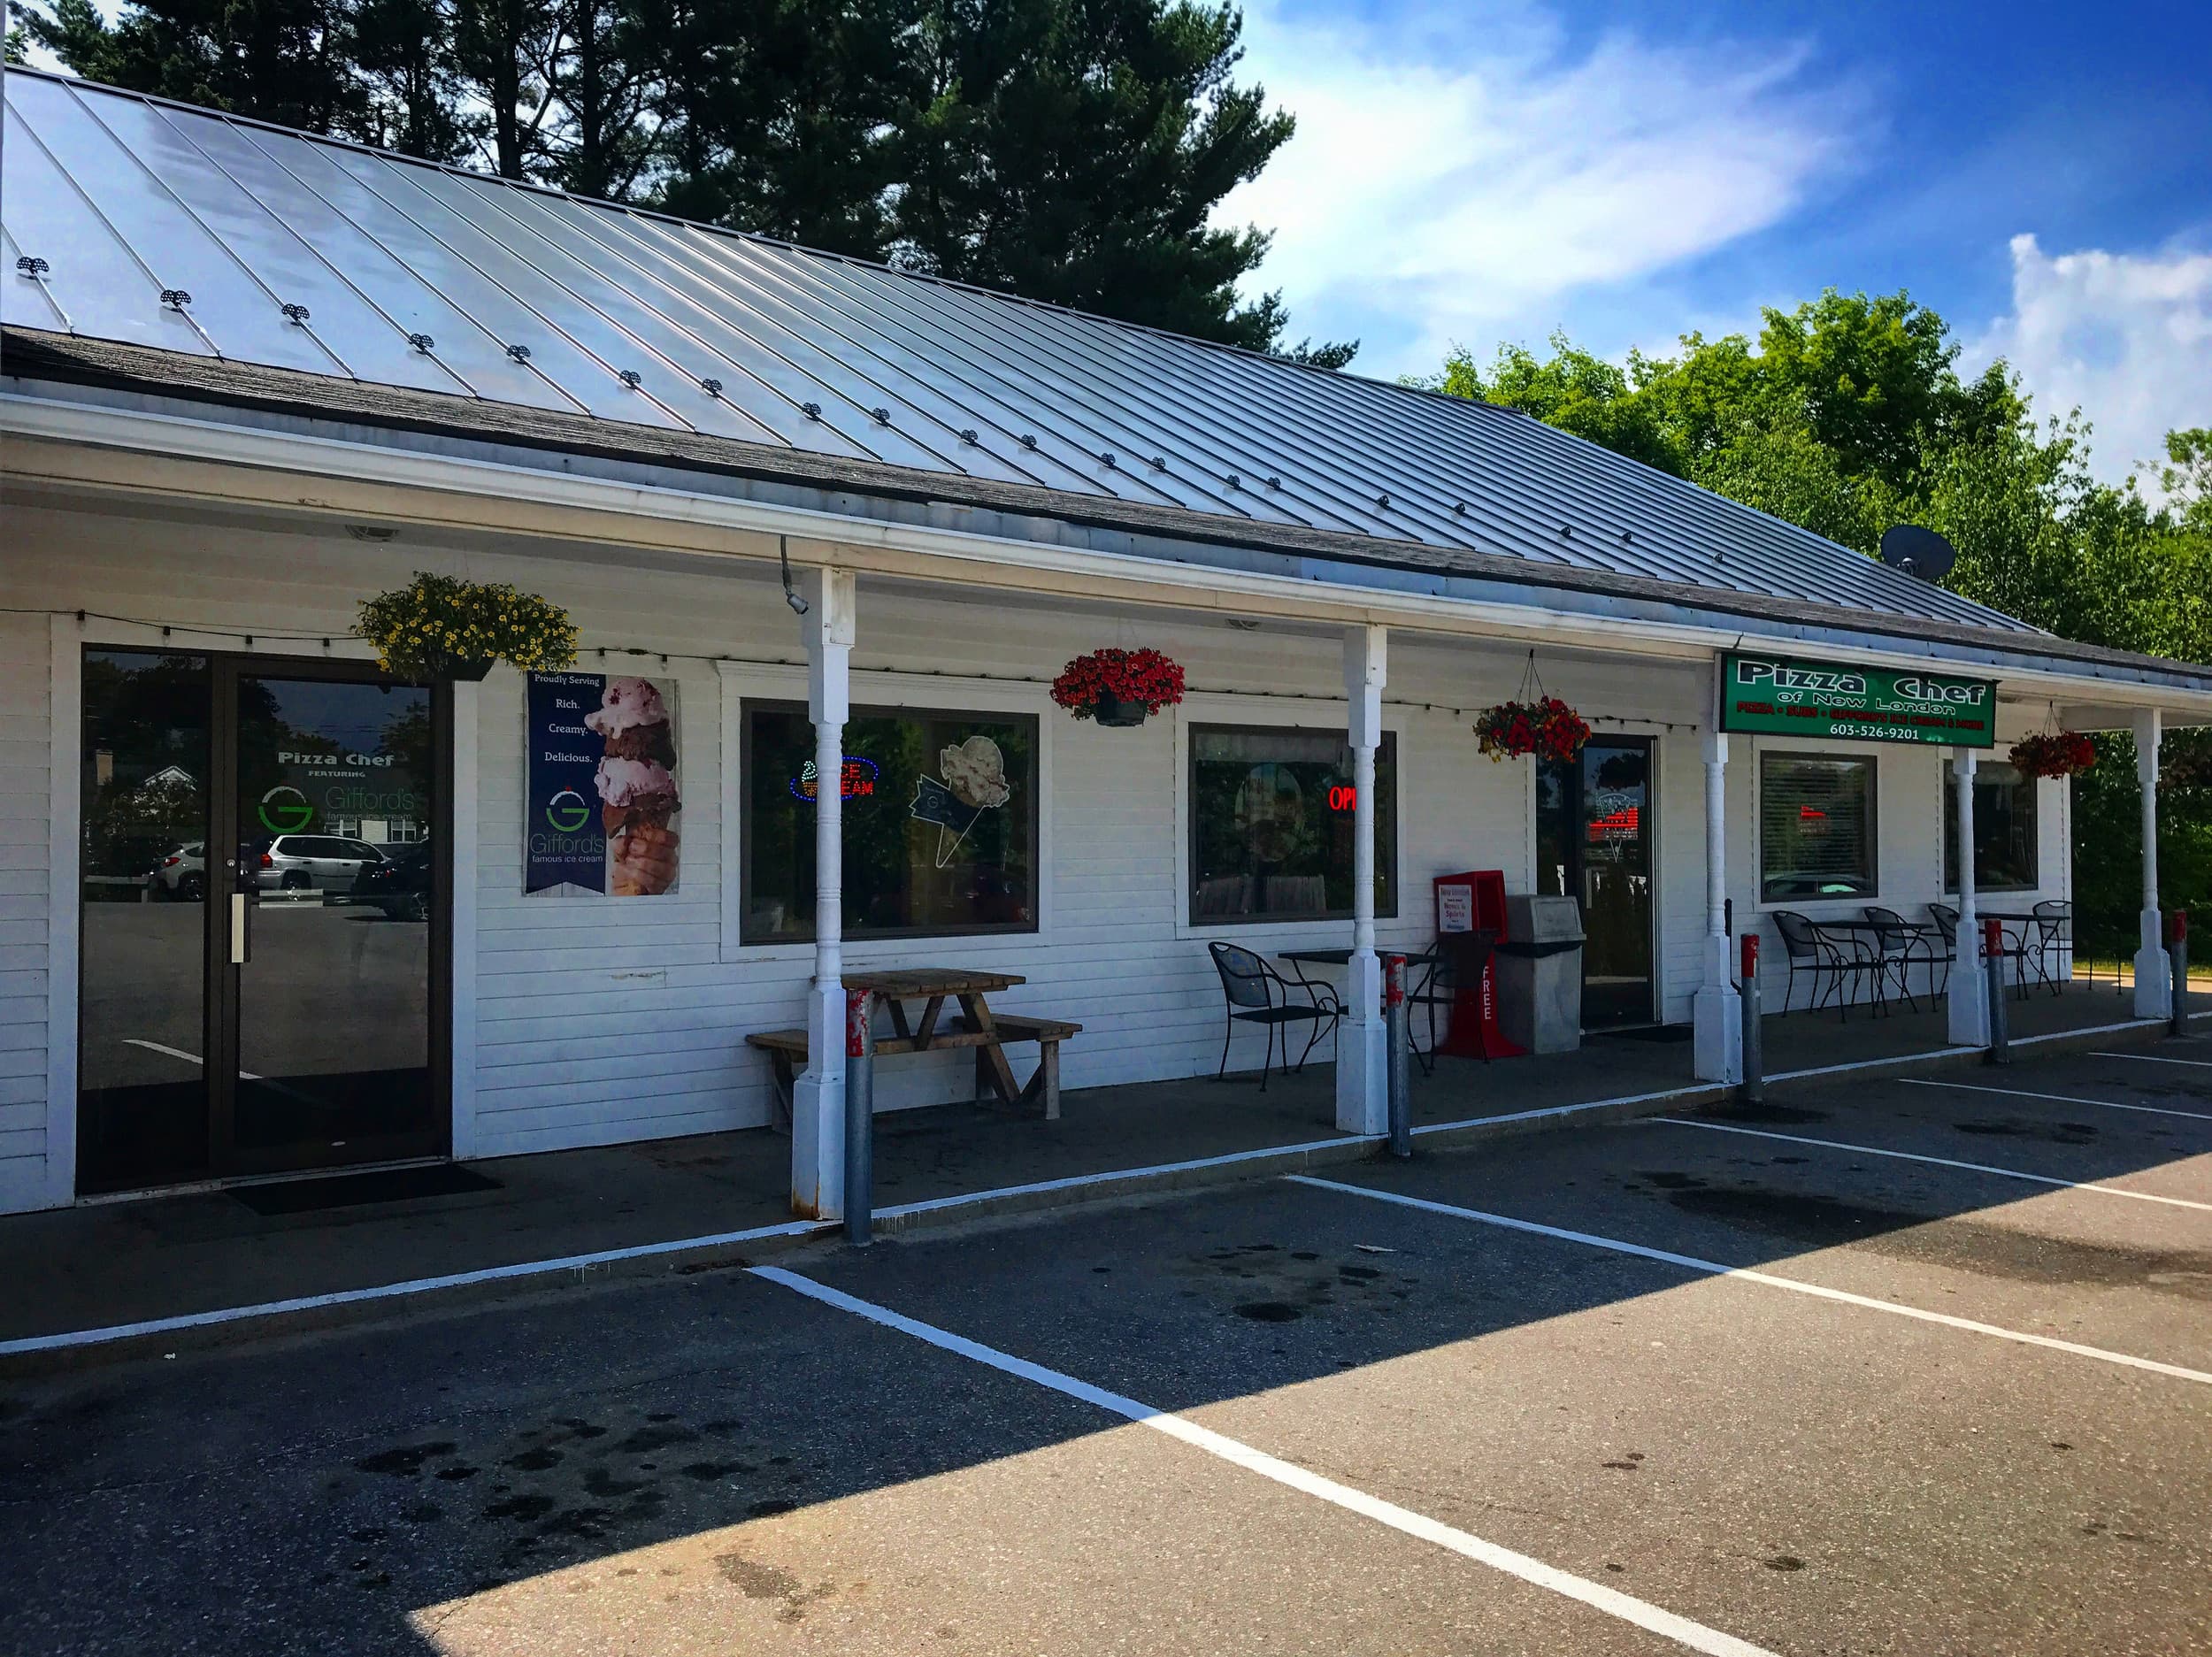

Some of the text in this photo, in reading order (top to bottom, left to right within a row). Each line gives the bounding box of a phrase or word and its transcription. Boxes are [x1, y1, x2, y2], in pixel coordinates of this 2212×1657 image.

[534, 673, 600, 687] Proudly Serving
[1737, 660, 1985, 705] Pizza Chef
[556, 699, 580, 710] Rich.
[1778, 691, 1956, 716] of New London
[1737, 701, 1775, 715] PIZZA
[1786, 705, 1818, 717] SUBS
[1890, 714, 1908, 725] ICE
[549, 724, 588, 736] Creamy.
[1830, 724, 1919, 740] 603-526-9201
[278, 752, 396, 766] Pizza Chef
[544, 751, 593, 763] Delicious.
[841, 763, 861, 779] CE
[841, 780, 874, 795] EAM
[532, 855, 563, 863] famous
[1483, 965, 1492, 1020] FREE
